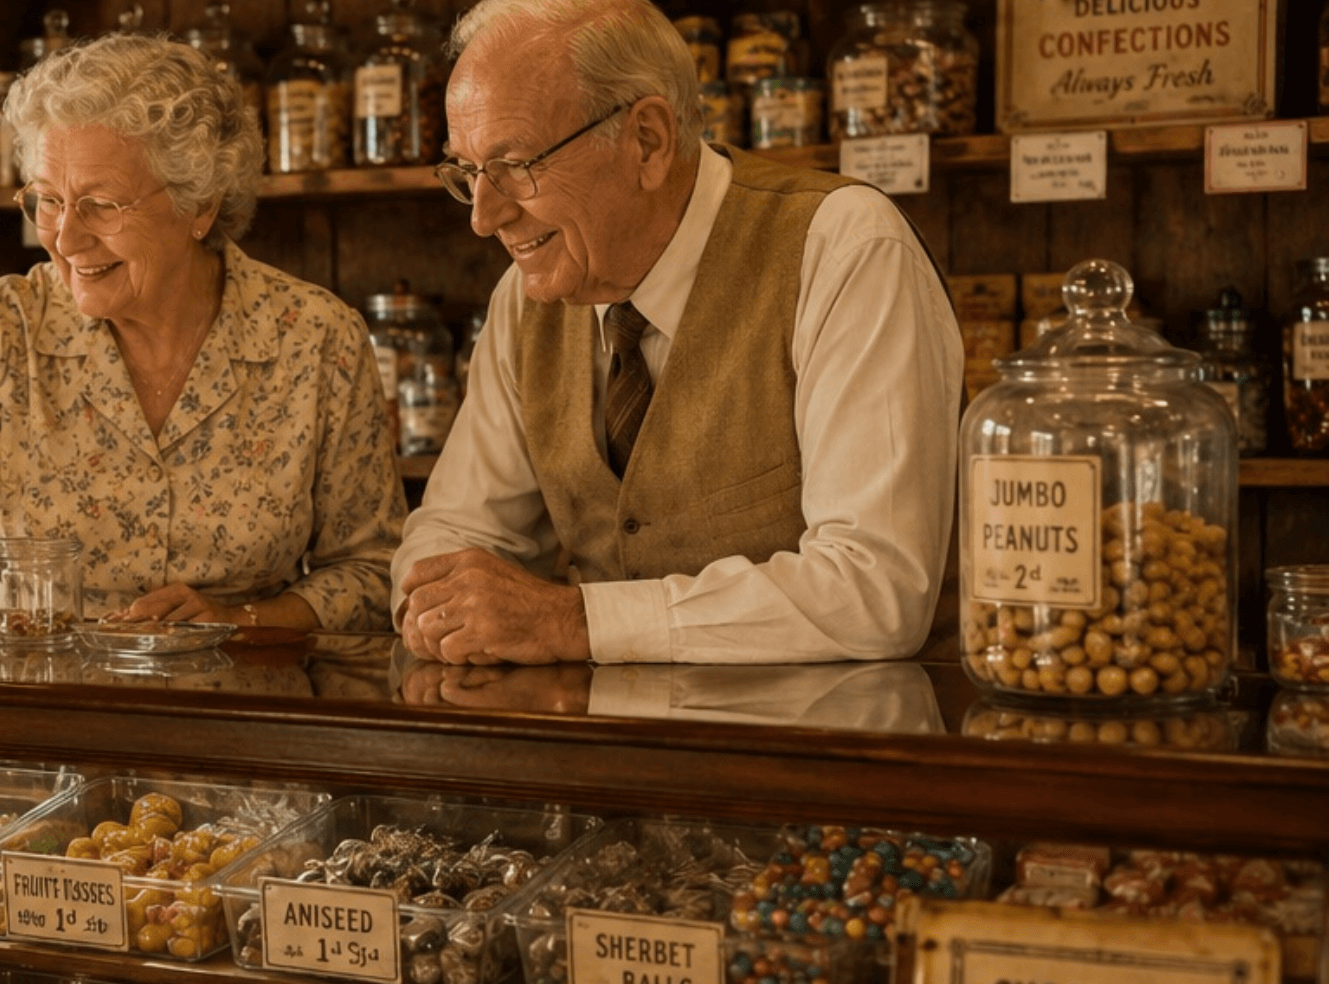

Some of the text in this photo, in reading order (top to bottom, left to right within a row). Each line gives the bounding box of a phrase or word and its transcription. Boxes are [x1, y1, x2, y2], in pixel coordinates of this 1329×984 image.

[1039, 20, 1231, 59] CONFECTIONS
[1049, 58, 1217, 100] Always Fresh
[989, 479, 1067, 508] JUMBO
[983, 523, 1079, 554] PEANUTS
[1014, 564, 1042, 590] 2d
[283, 901, 374, 934] ANISEED
[595, 932, 696, 969] SHERBET
